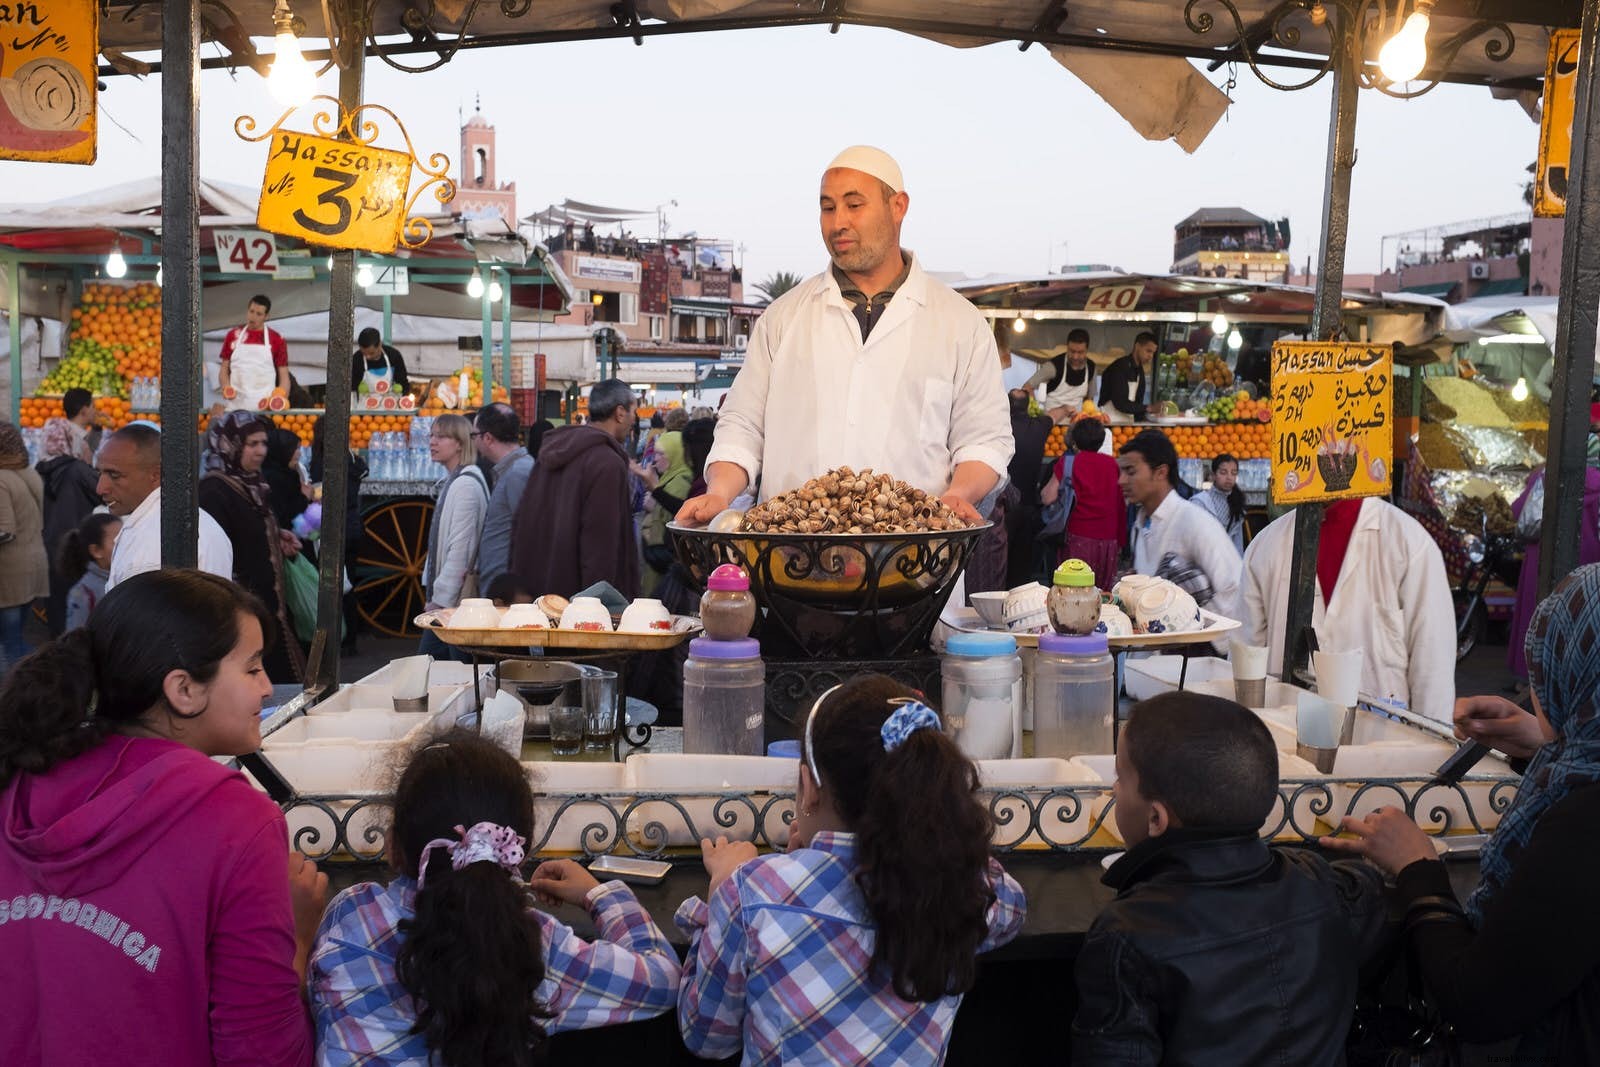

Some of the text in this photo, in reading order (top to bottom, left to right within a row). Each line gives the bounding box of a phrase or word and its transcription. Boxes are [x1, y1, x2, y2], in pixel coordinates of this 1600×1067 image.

[272, 136, 392, 173] Hassan
[293, 167, 359, 235] 3
[229, 237, 276, 272] 42
[1090, 287, 1137, 309] 40
[1275, 348, 1334, 373] Hassan
[1336, 347, 1385, 371] حسن
[1275, 382, 1288, 412] 5
[1284, 406, 1304, 423] DH
[1336, 402, 1386, 438] كبيرة
[1278, 431, 1298, 466] 10
[1294, 455, 1312, 472] DH
